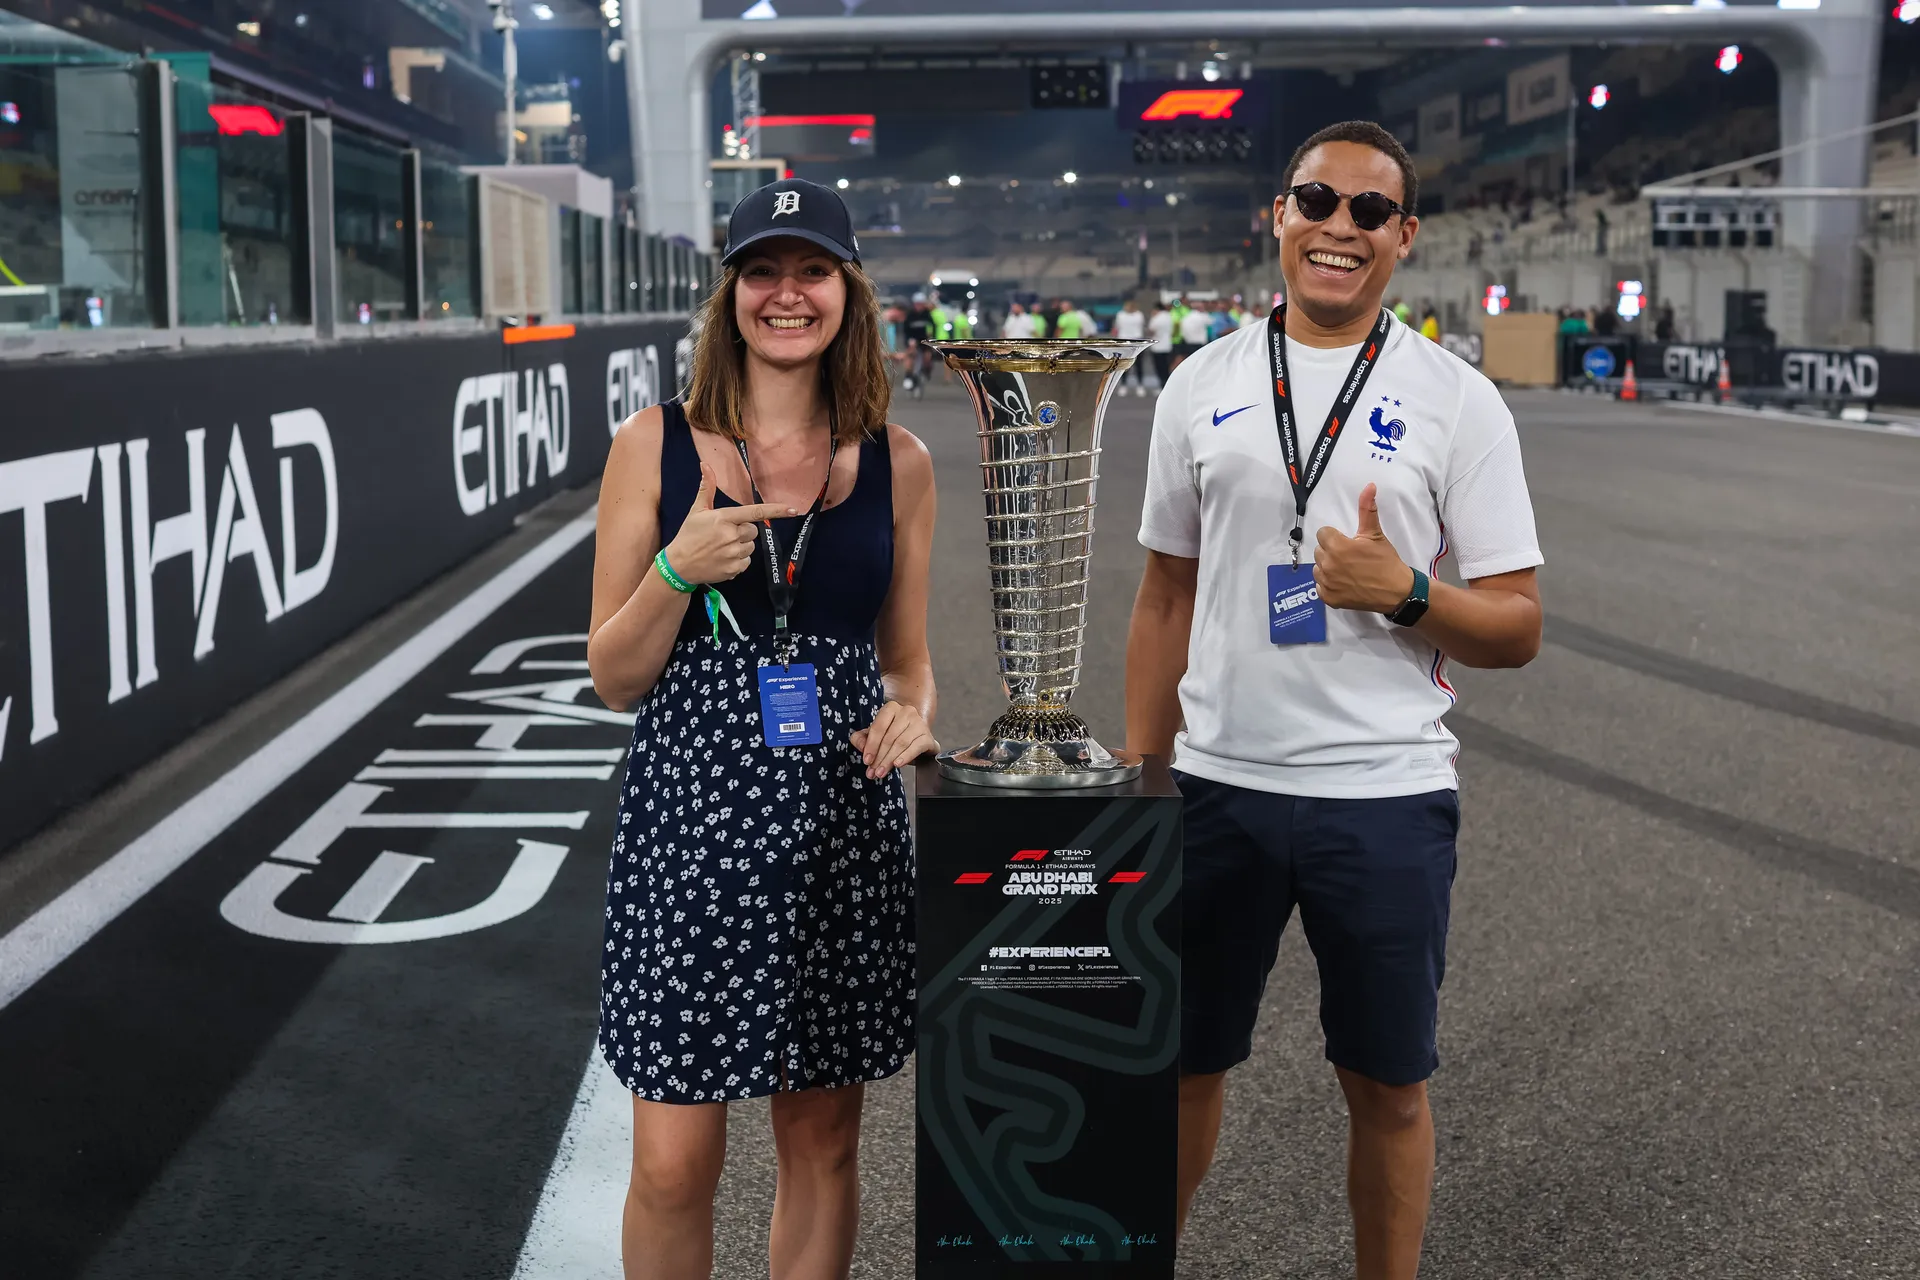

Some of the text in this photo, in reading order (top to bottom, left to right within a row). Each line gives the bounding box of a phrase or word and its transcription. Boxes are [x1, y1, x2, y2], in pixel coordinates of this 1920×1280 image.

[771, 190, 801, 220] D
[1273, 332, 1283, 379] Experiences
[1782, 352, 1879, 398] ETIHAD
[1342, 359, 1370, 404] Experiences
[453, 363, 570, 516] ETIHAD
[1282, 412, 1295, 464] Experiences
[1306, 436, 1332, 489] Experiences
[765, 528, 780, 584] Experiences
[790, 513, 814, 560] Experiences
[0, 408, 339, 762] TIHAD
[1273, 587, 1319, 614] HERO
[1287, 580, 1315, 594] Experiences
[1002, 883, 1098, 895] GRAND PRIX
[1008, 872, 1093, 883] ABU DHABI
[988, 946, 1111, 958] #EXPERIENCEF1
